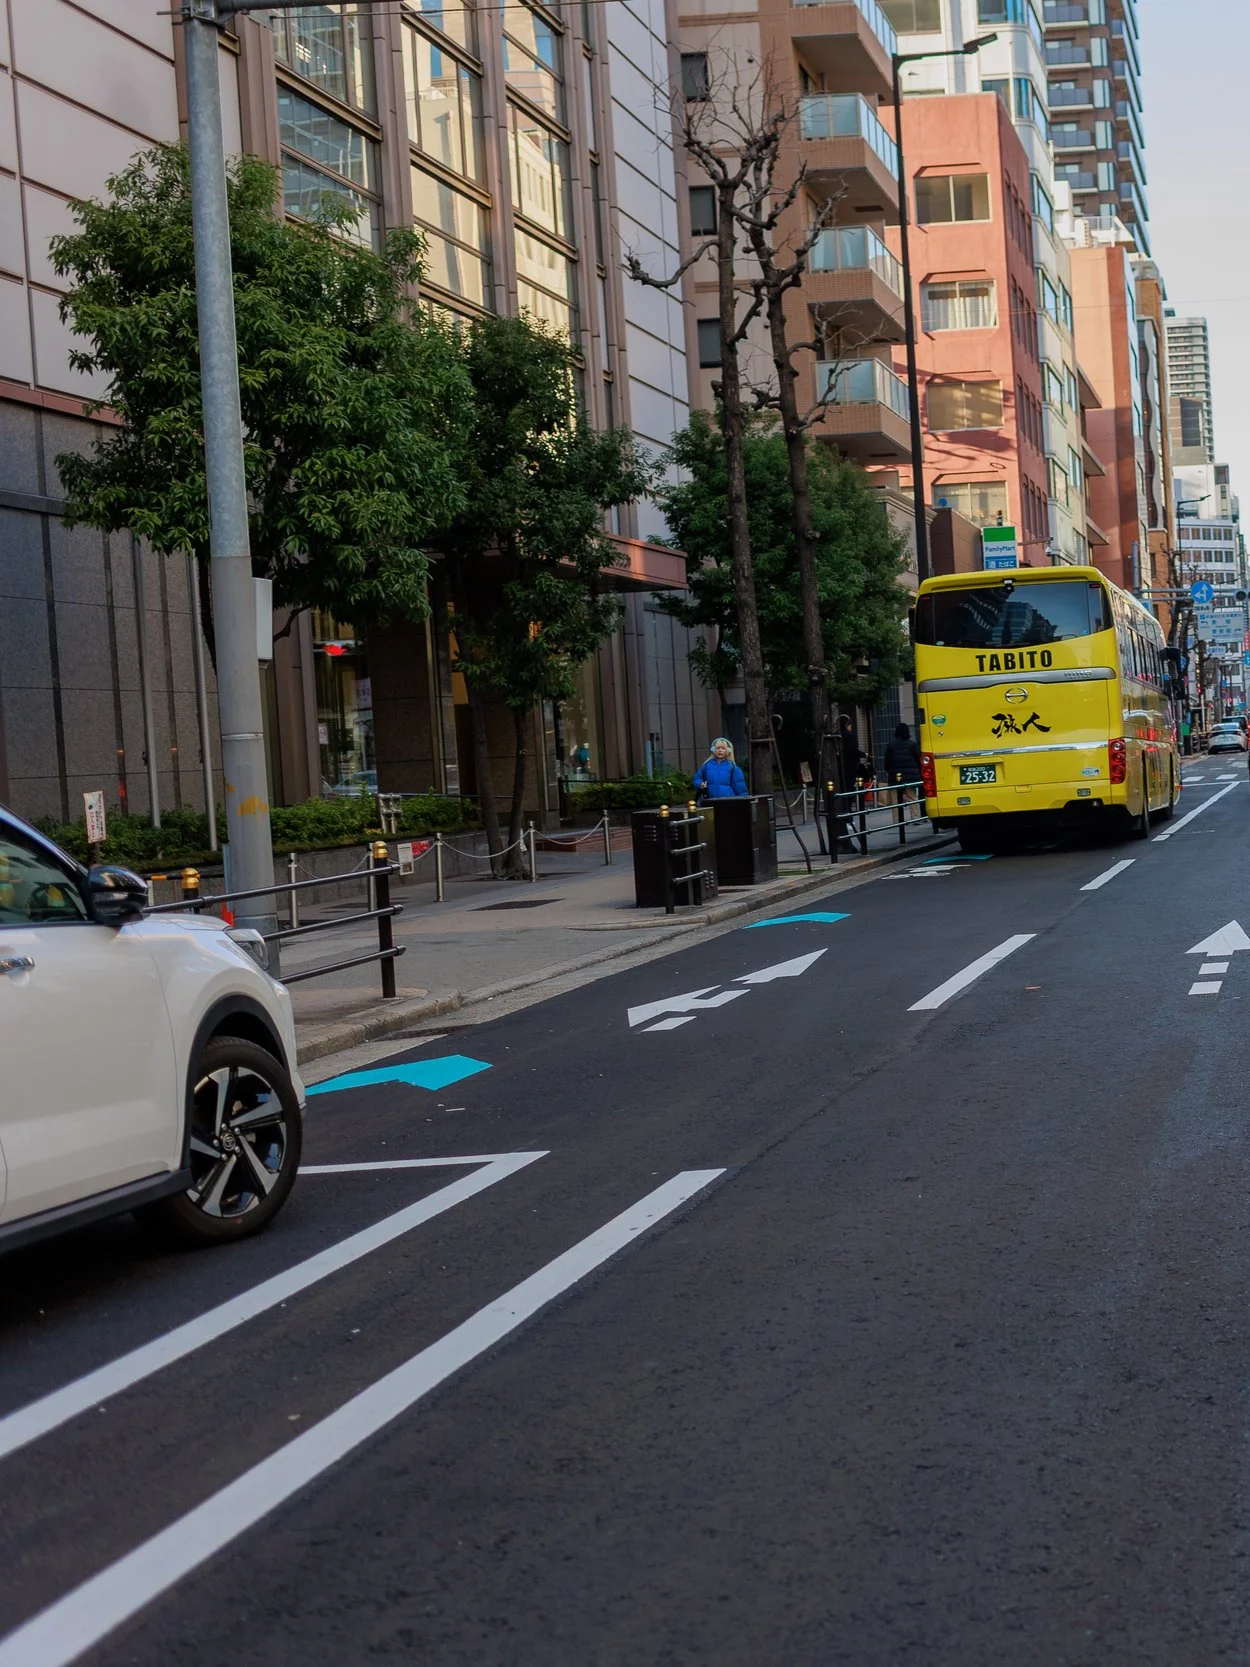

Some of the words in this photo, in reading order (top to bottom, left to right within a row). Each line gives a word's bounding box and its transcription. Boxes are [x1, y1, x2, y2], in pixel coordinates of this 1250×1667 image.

[975, 650, 1053, 673] TABITO
[991, 712, 1052, 738] 旅人
[965, 770, 996, 783] 25-32
